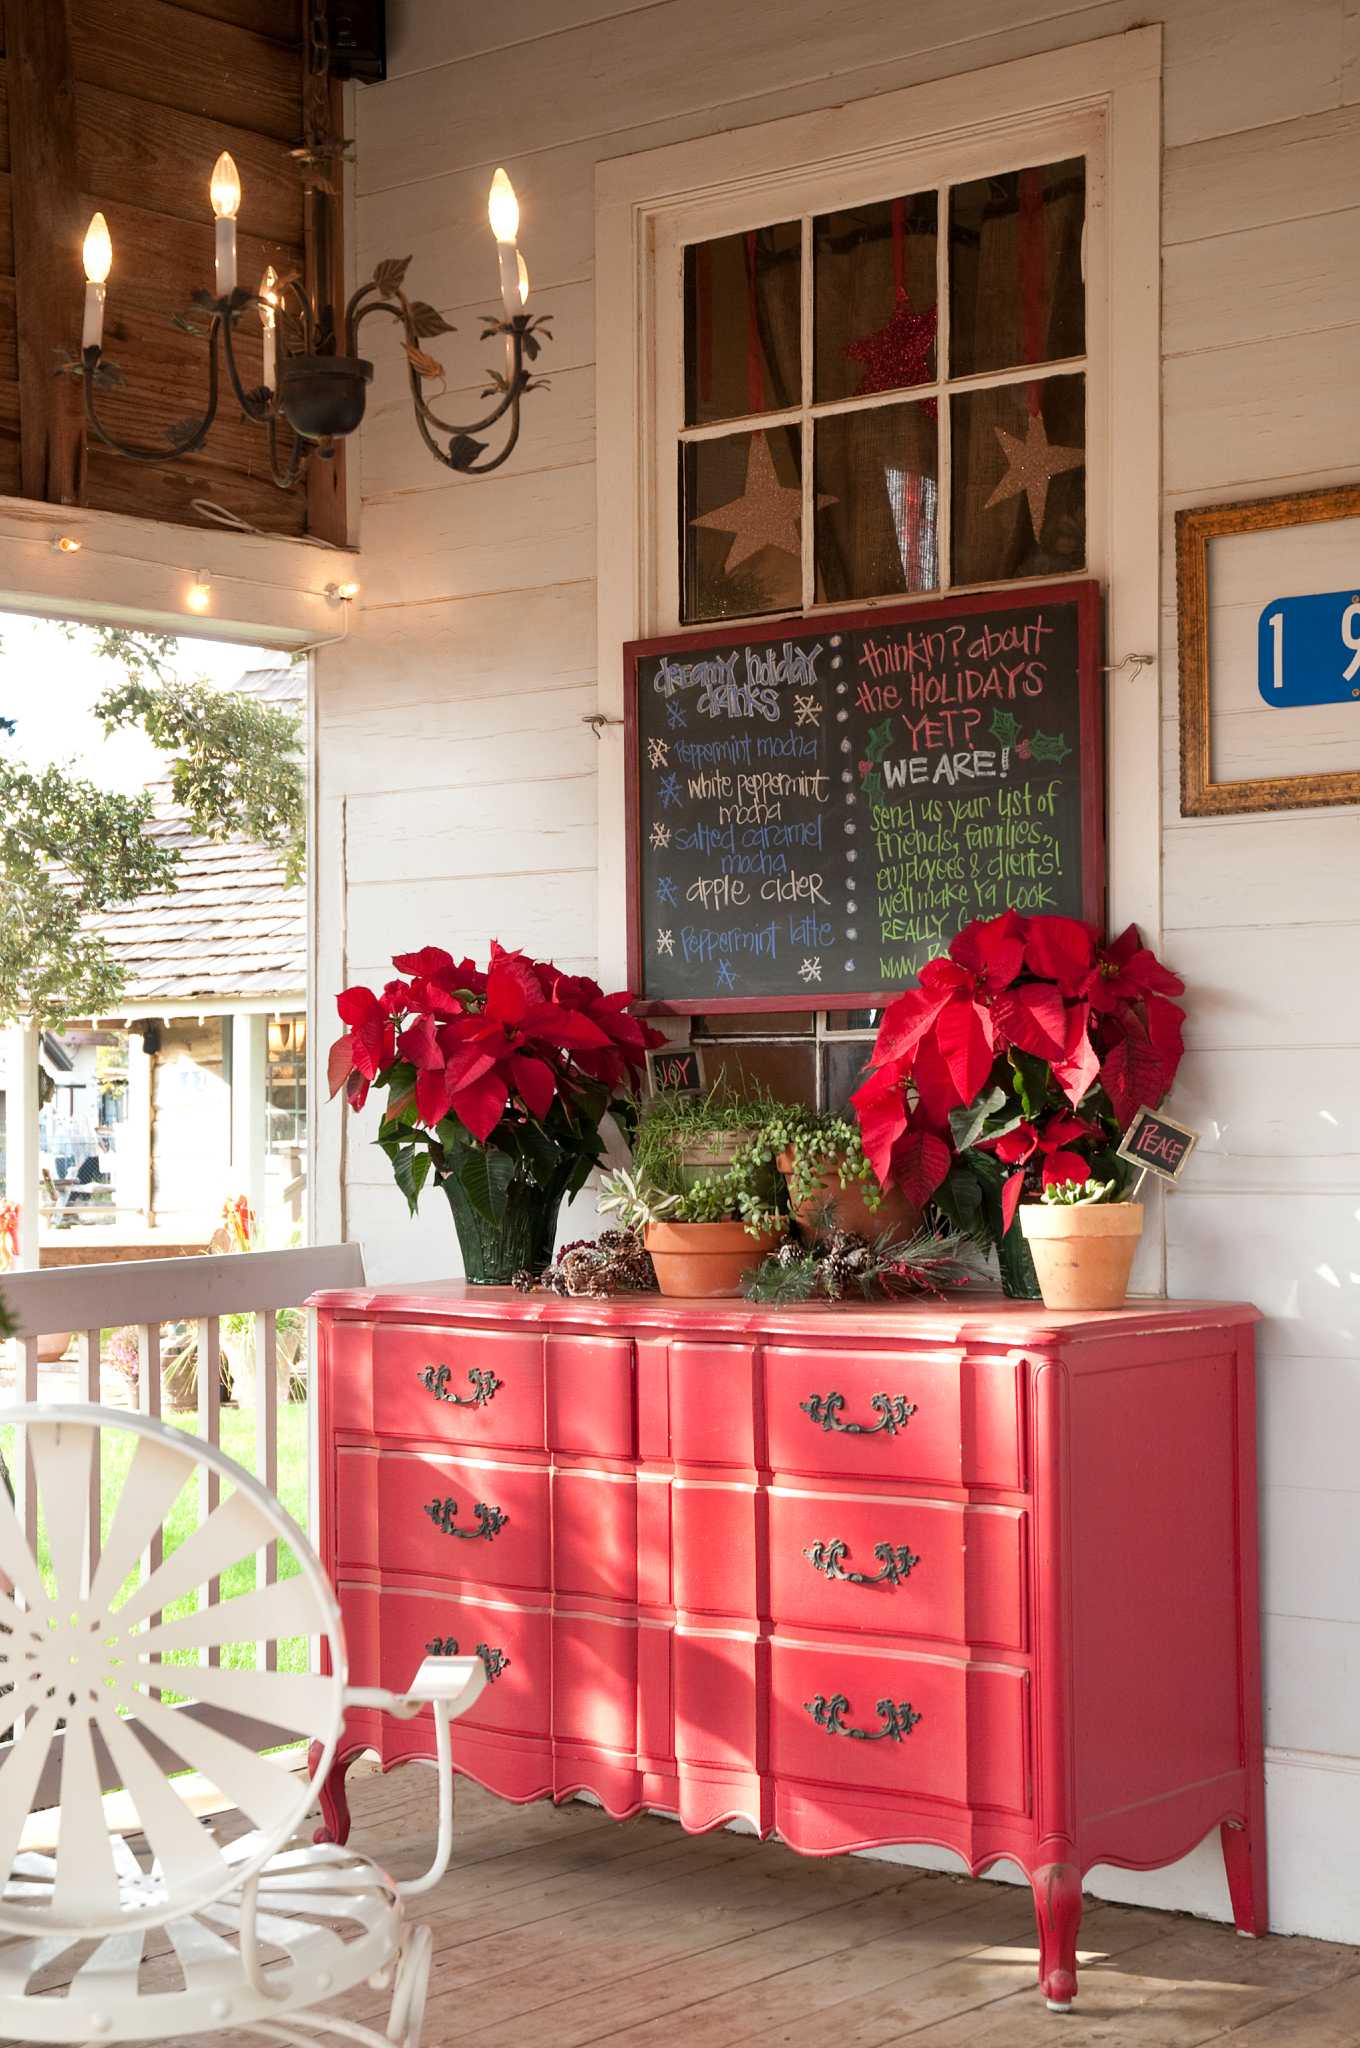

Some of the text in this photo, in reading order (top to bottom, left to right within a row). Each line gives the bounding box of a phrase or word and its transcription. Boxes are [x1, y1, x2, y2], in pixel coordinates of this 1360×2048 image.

[855, 681, 902, 713] the
[902, 708, 981, 752] YET?
[688, 769, 734, 800] white
[883, 747, 1009, 789] WE ARE!
[719, 797, 782, 825] mocha
[1037, 780, 1062, 816] of
[742, 814, 822, 852] caramel
[721, 850, 787, 876] mocha
[686, 874, 750, 911] apple
[881, 912, 949, 944] REALLY
